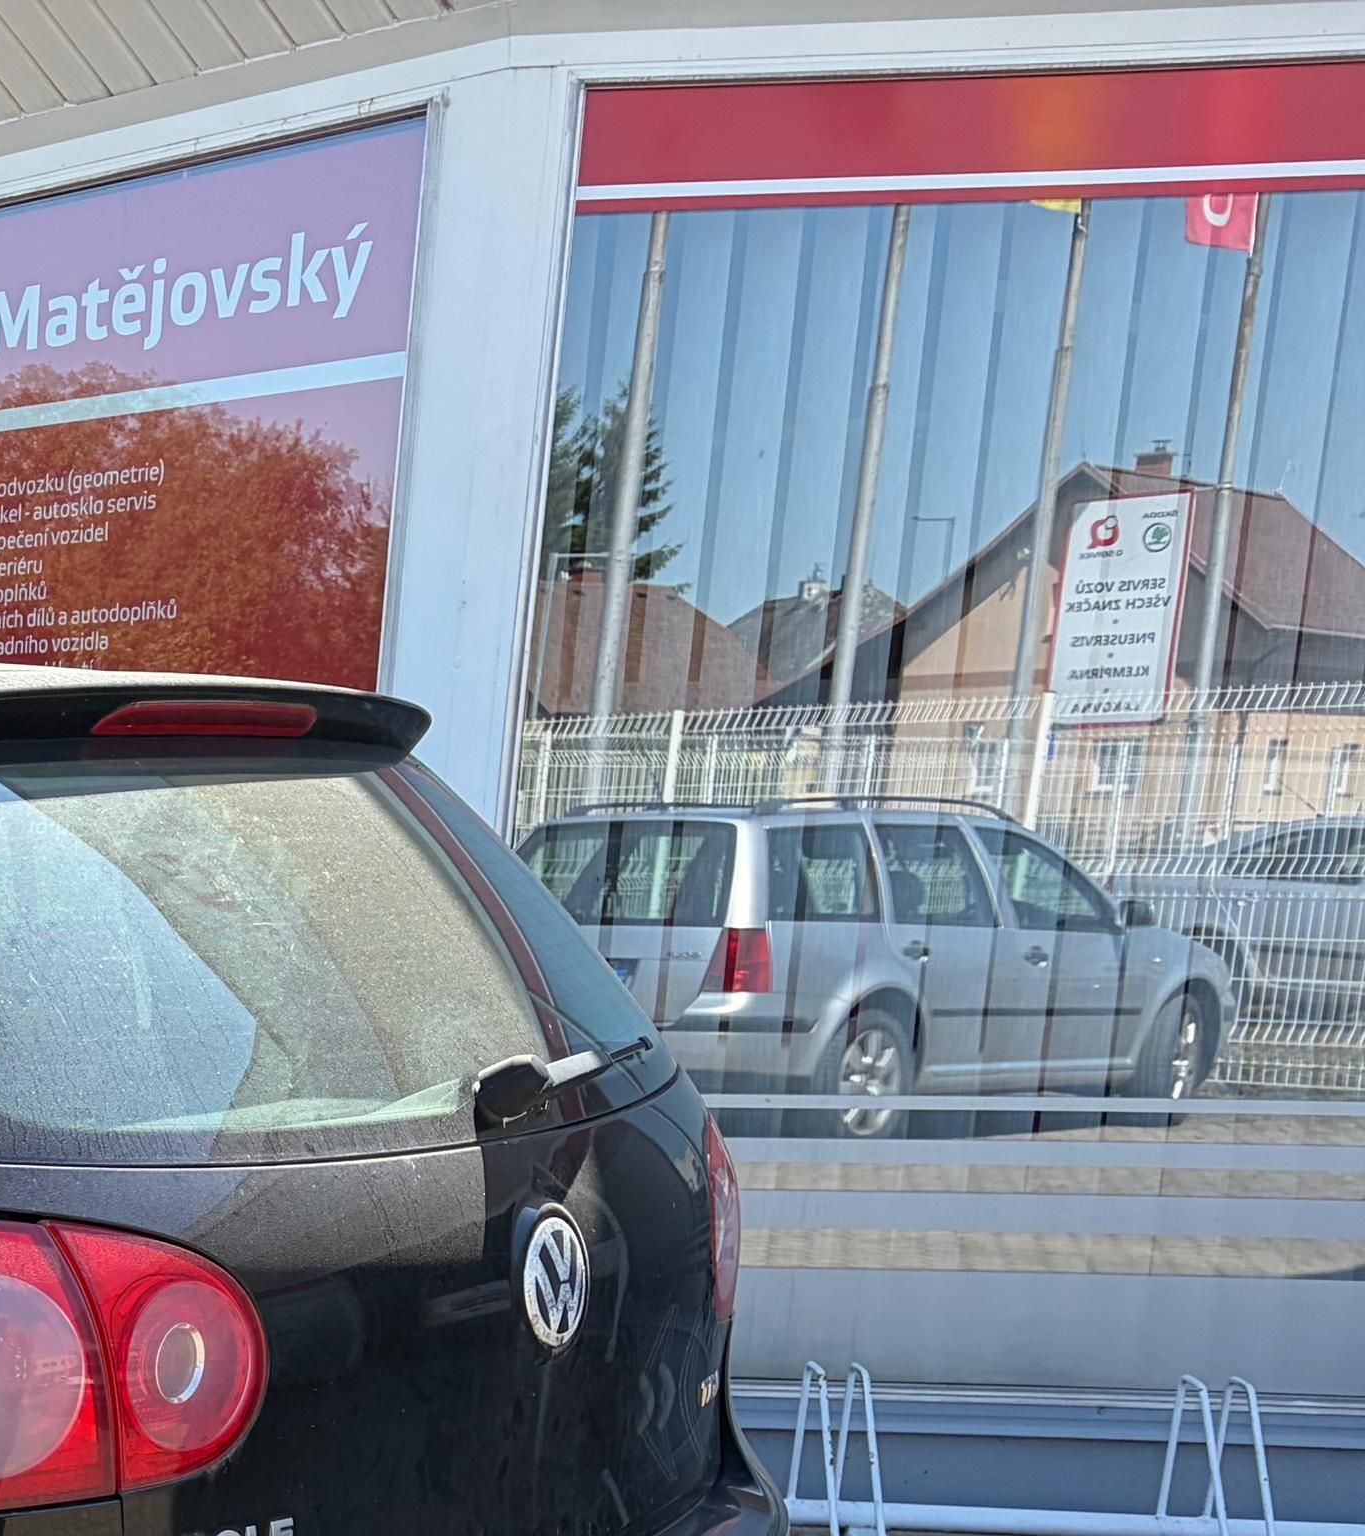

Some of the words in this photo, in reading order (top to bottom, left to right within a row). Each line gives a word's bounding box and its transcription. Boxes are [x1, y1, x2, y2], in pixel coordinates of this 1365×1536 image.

[68, 458, 165, 496] (geometrie)
[33, 495, 104, 521] autosklo
[106, 491, 156, 513] servis
[51, 522, 109, 547] vozidel
[27, 606, 55, 628] dílů
[58, 609, 67, 626] a
[71, 598, 178, 626] autodoplňků
[51, 631, 109, 651] vozidla
